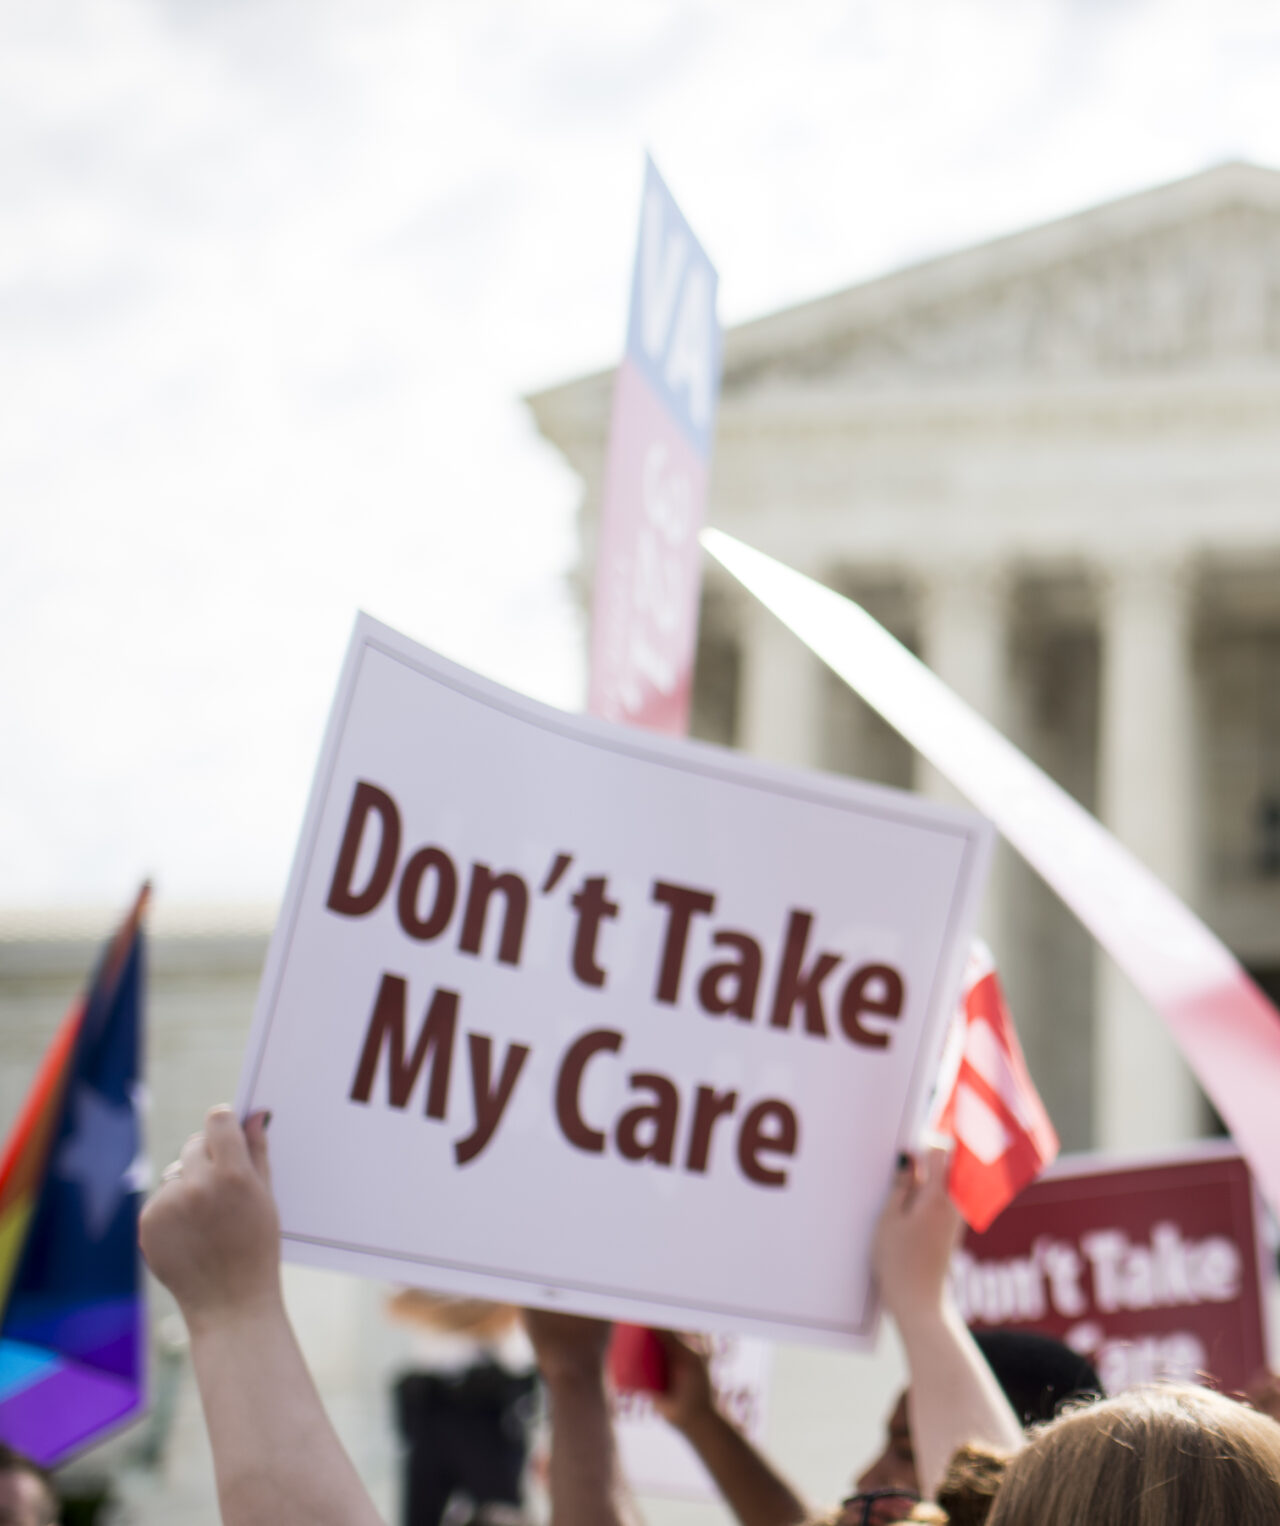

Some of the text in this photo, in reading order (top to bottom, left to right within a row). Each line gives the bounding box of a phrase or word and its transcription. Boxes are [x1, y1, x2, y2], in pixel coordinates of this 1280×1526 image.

[324, 779, 907, 1052] Don't Take
[347, 972, 801, 1190] My Care
[1082, 1221, 1245, 1312] Take
